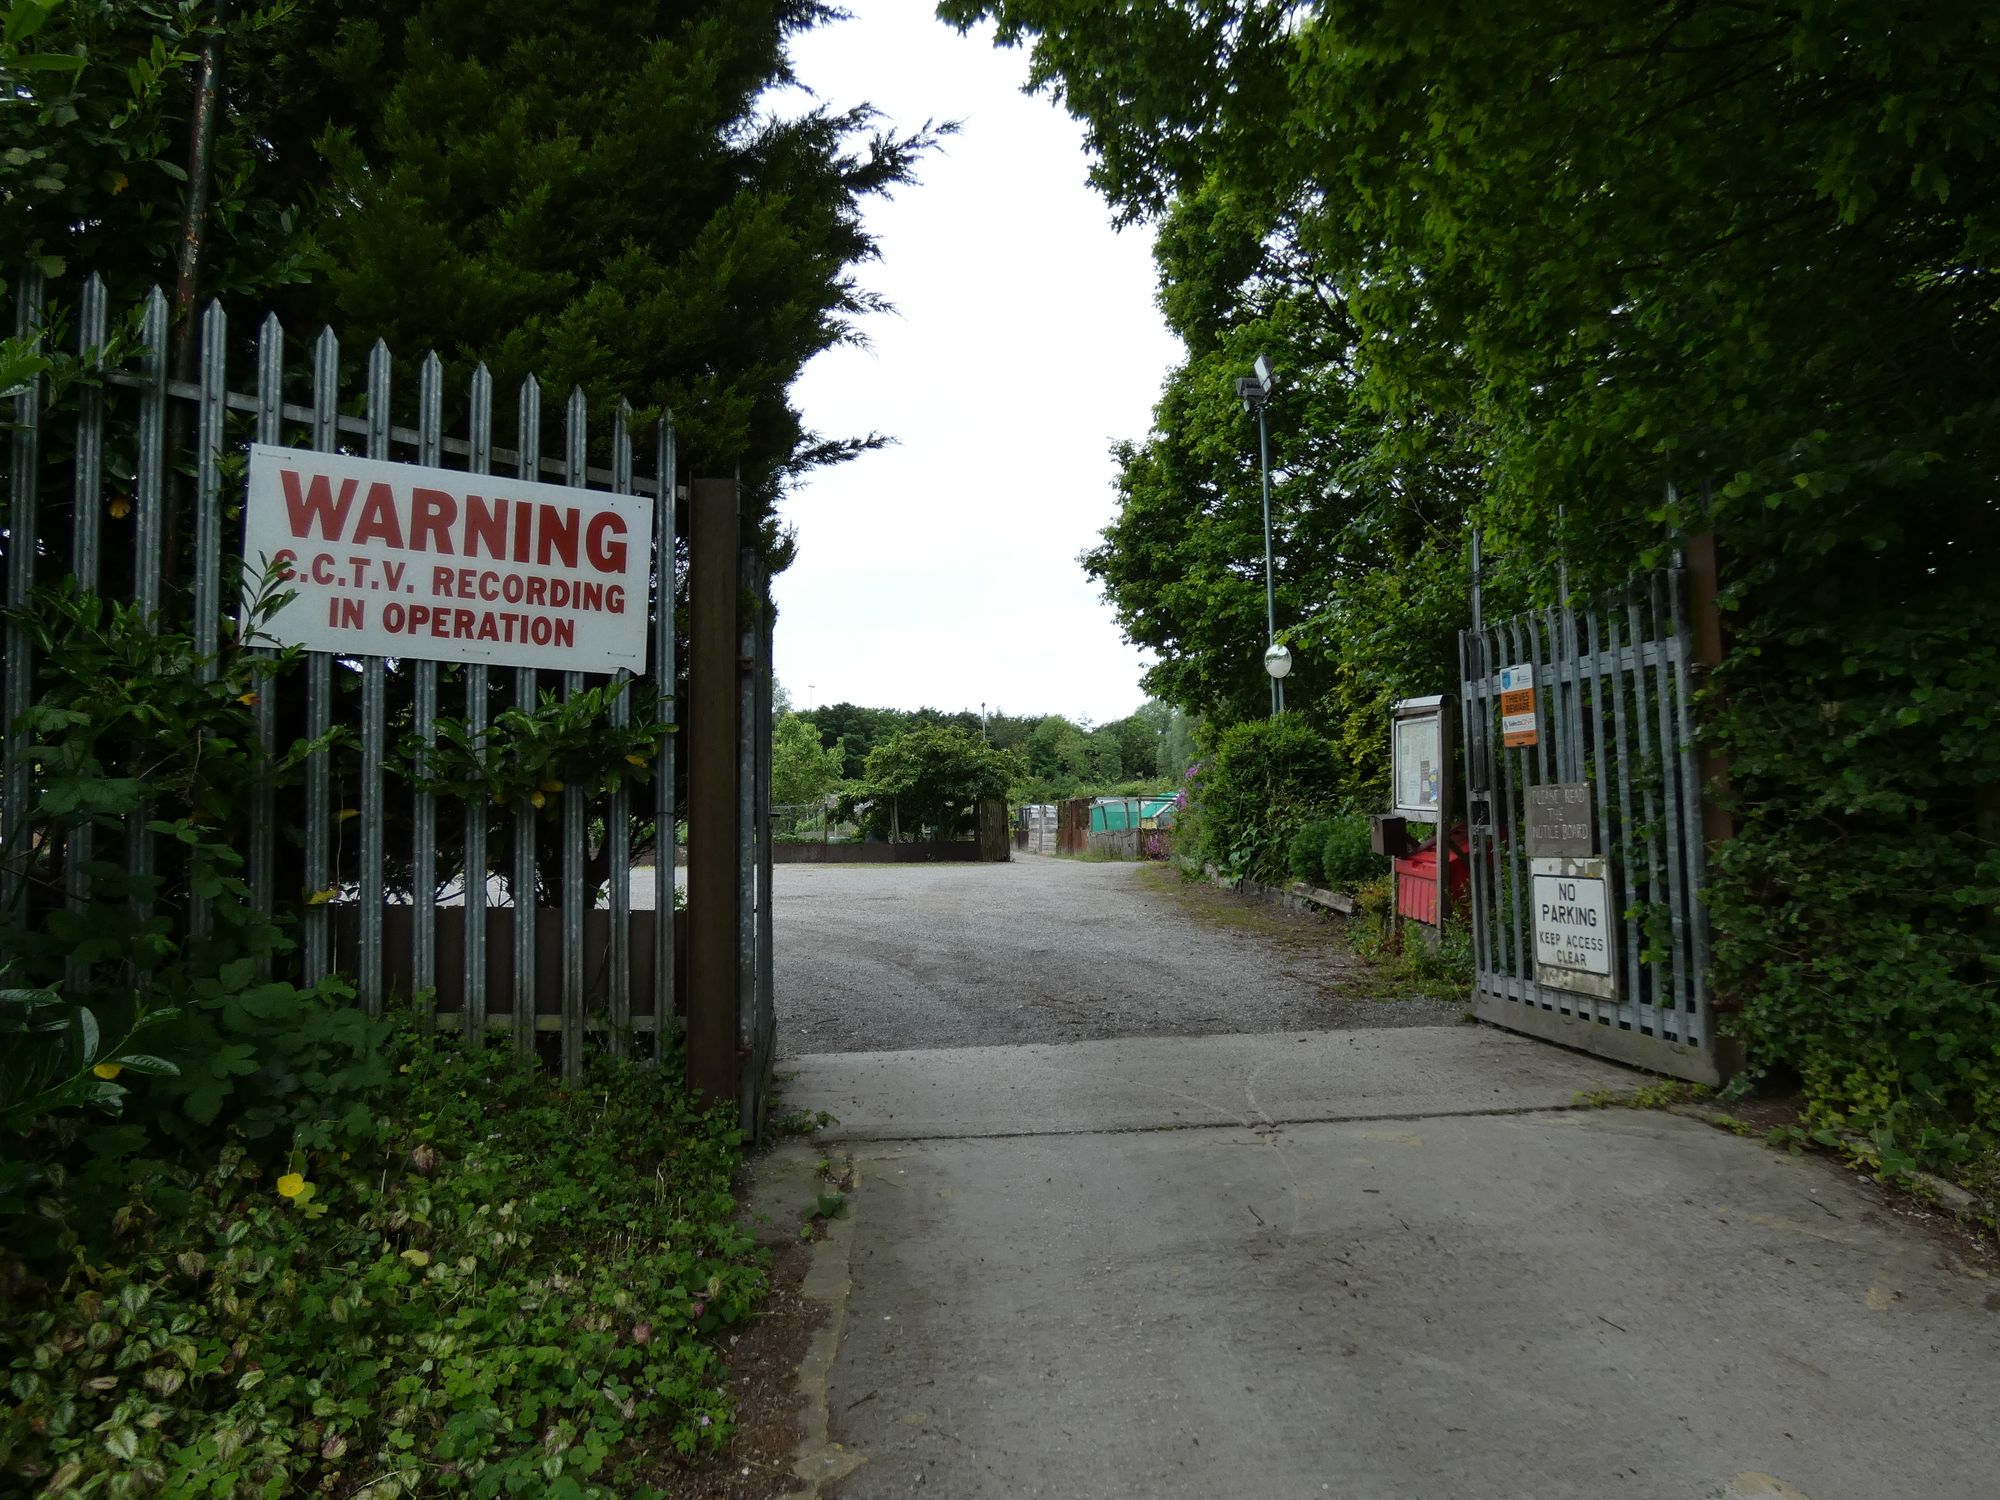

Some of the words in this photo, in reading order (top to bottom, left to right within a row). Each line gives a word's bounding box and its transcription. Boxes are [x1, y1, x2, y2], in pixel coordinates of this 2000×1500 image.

[280, 470, 628, 574] WARNING
[272, 548, 415, 593] C.C.T.V.
[432, 566, 625, 614] RECORDING
[329, 597, 365, 630] IN
[382, 602, 574, 648] OPERATION
[1504, 691, 1530, 704] THIEVES
[1505, 701, 1531, 713] BEWARE
[1532, 789, 1560, 805] PLEASE
[1564, 788, 1585, 804] READ
[1546, 807, 1565, 822] THE
[1532, 824, 1560, 841] NOTICE
[1561, 823, 1589, 840] BOARD
[1558, 883, 1576, 902] NO
[1542, 903, 1597, 927] PARKING
[1539, 931, 1561, 946] KEEP
[1566, 935, 1604, 952] ACCESS
[1557, 950, 1587, 967] CLEAR
